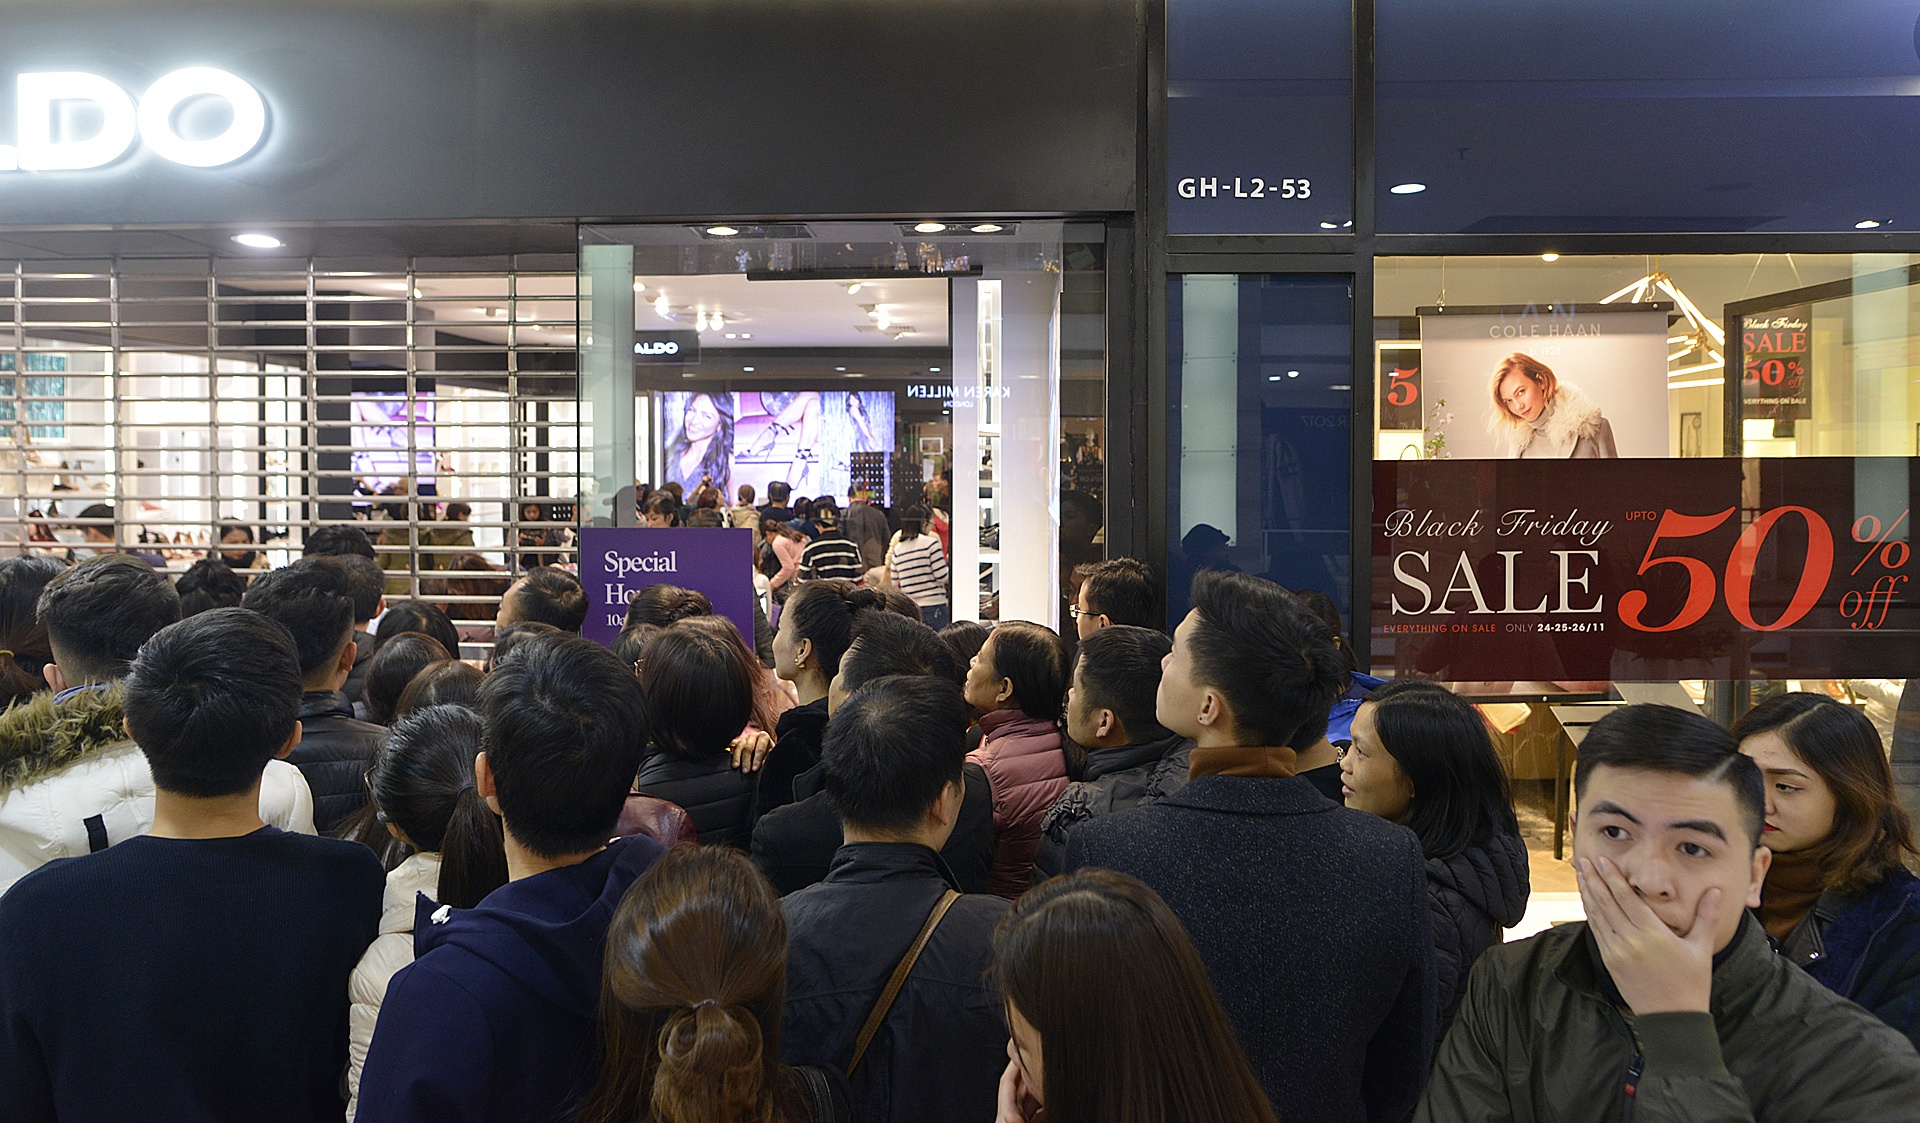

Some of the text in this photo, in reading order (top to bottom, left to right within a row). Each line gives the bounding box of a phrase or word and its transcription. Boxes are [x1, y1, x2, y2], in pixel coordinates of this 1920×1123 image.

[1177, 177, 1311, 199] GH-L2-53
[1489, 323, 1601, 338] COLE HAAN
[1743, 318, 1769, 329] Black
[634, 341, 679, 355] ALDO
[1743, 332, 1808, 353] SALE
[1743, 359, 1786, 386] 50
[1388, 367, 1421, 406] 5
[1743, 397, 1779, 405] VERYTHING
[1383, 508, 1614, 546] Black Friday
[604, 550, 678, 579] Special
[1617, 505, 1911, 632] UPTO 50 %
[604, 583, 641, 604] Ho
[1391, 550, 1603, 616] SALE
[1839, 575, 1909, 630] off
[1383, 622, 1605, 633] EVERYTHING ON SALE ONLY 24-25-26/11
